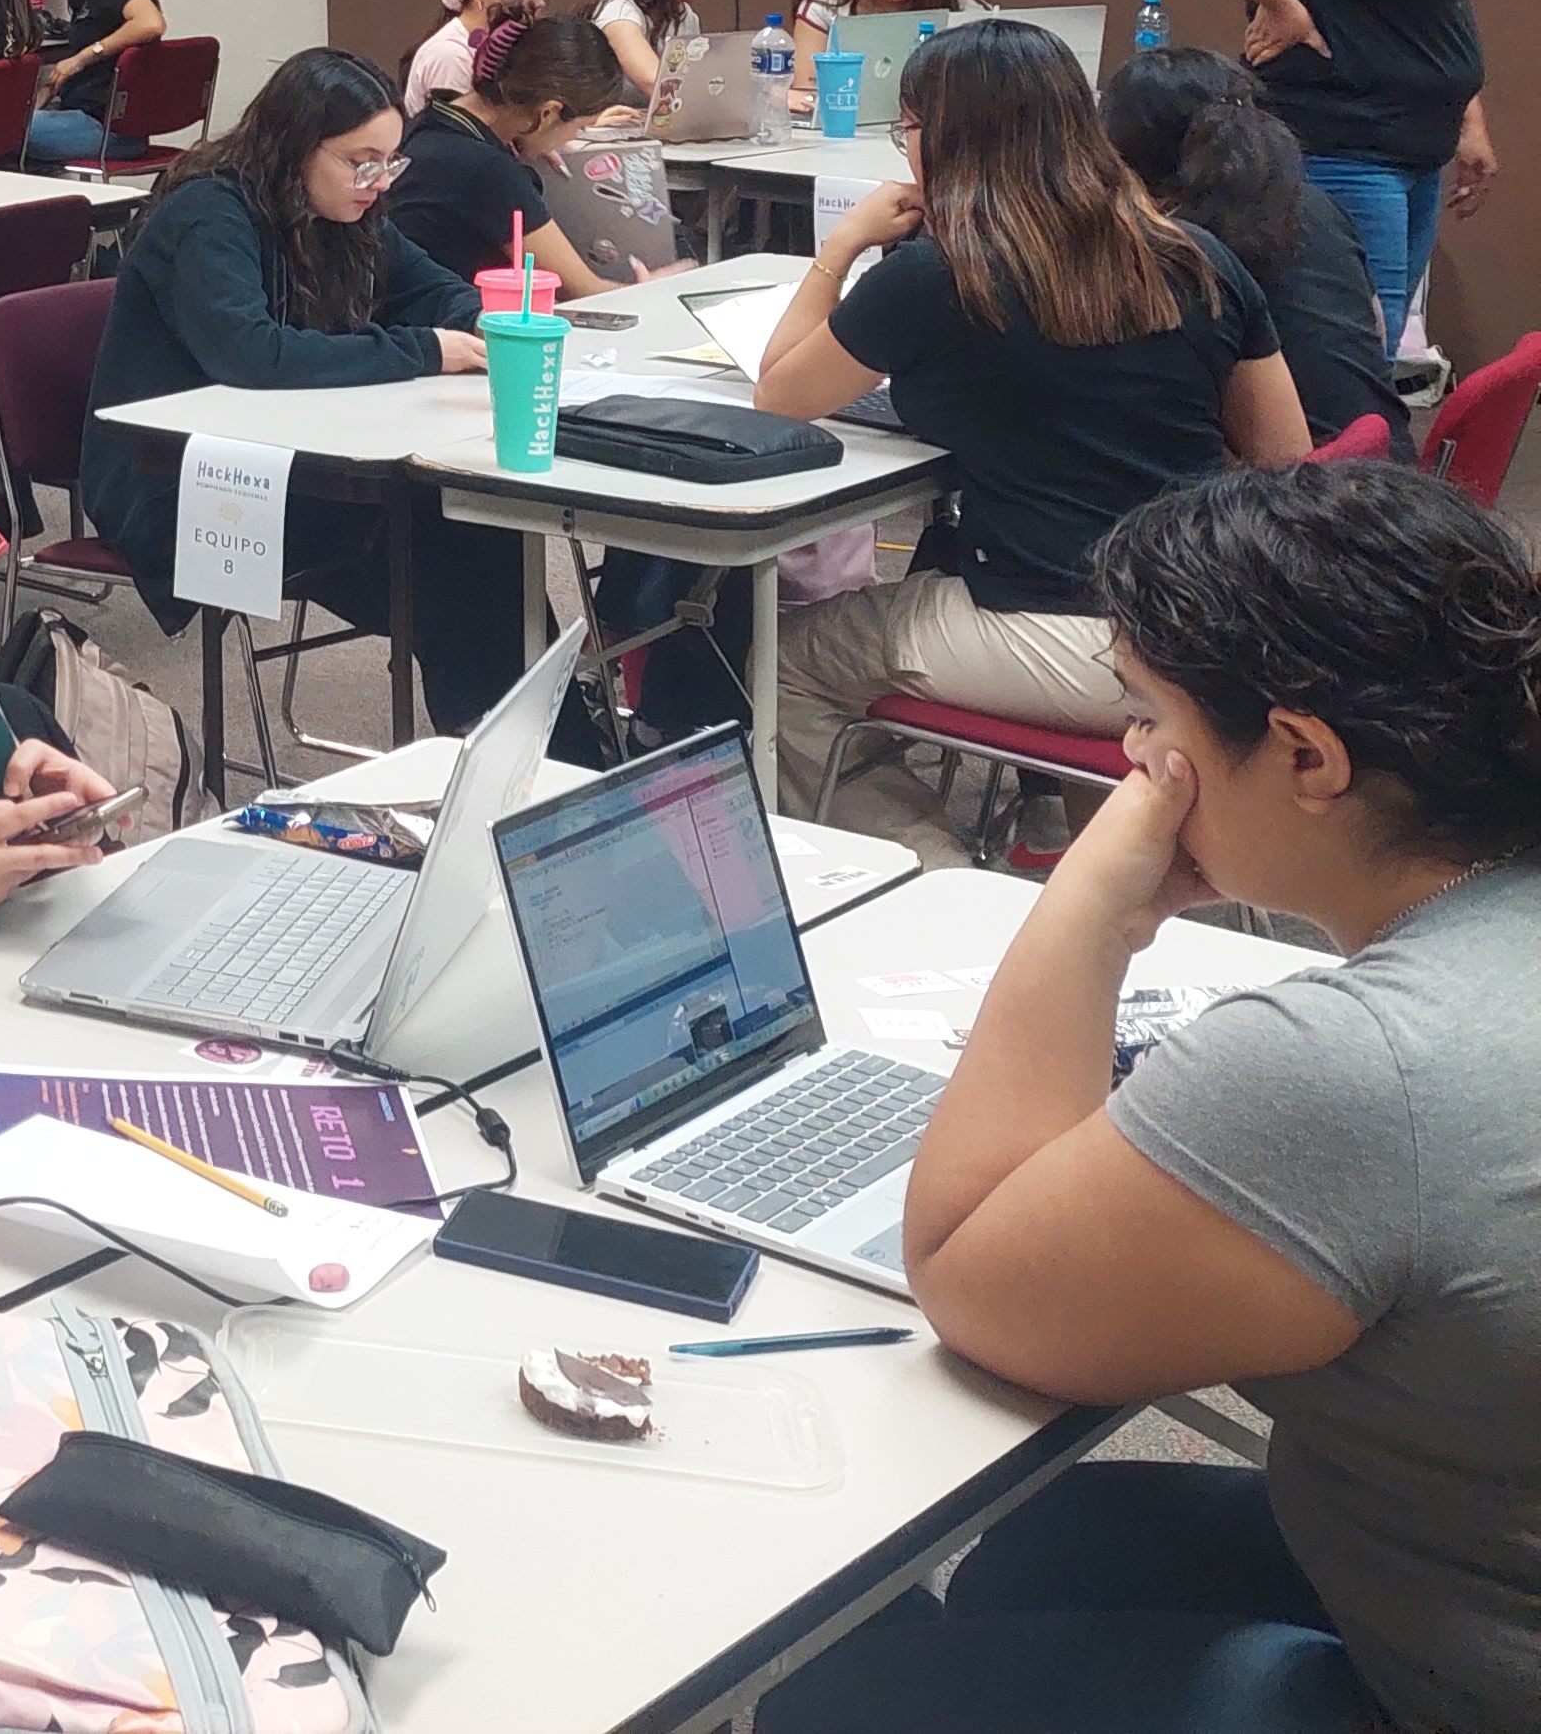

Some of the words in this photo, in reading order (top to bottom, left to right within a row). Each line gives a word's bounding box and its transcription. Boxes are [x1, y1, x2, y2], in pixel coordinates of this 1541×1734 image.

[818, 196, 857, 210] HackHe
[526, 342, 558, 457] HackHexa
[196, 459, 271, 491] HackHexa
[194, 527, 267, 557] EQUIPO
[223, 558, 235, 575] 8
[309, 1104, 357, 1161] RETO
[331, 1174, 366, 1189] 1
